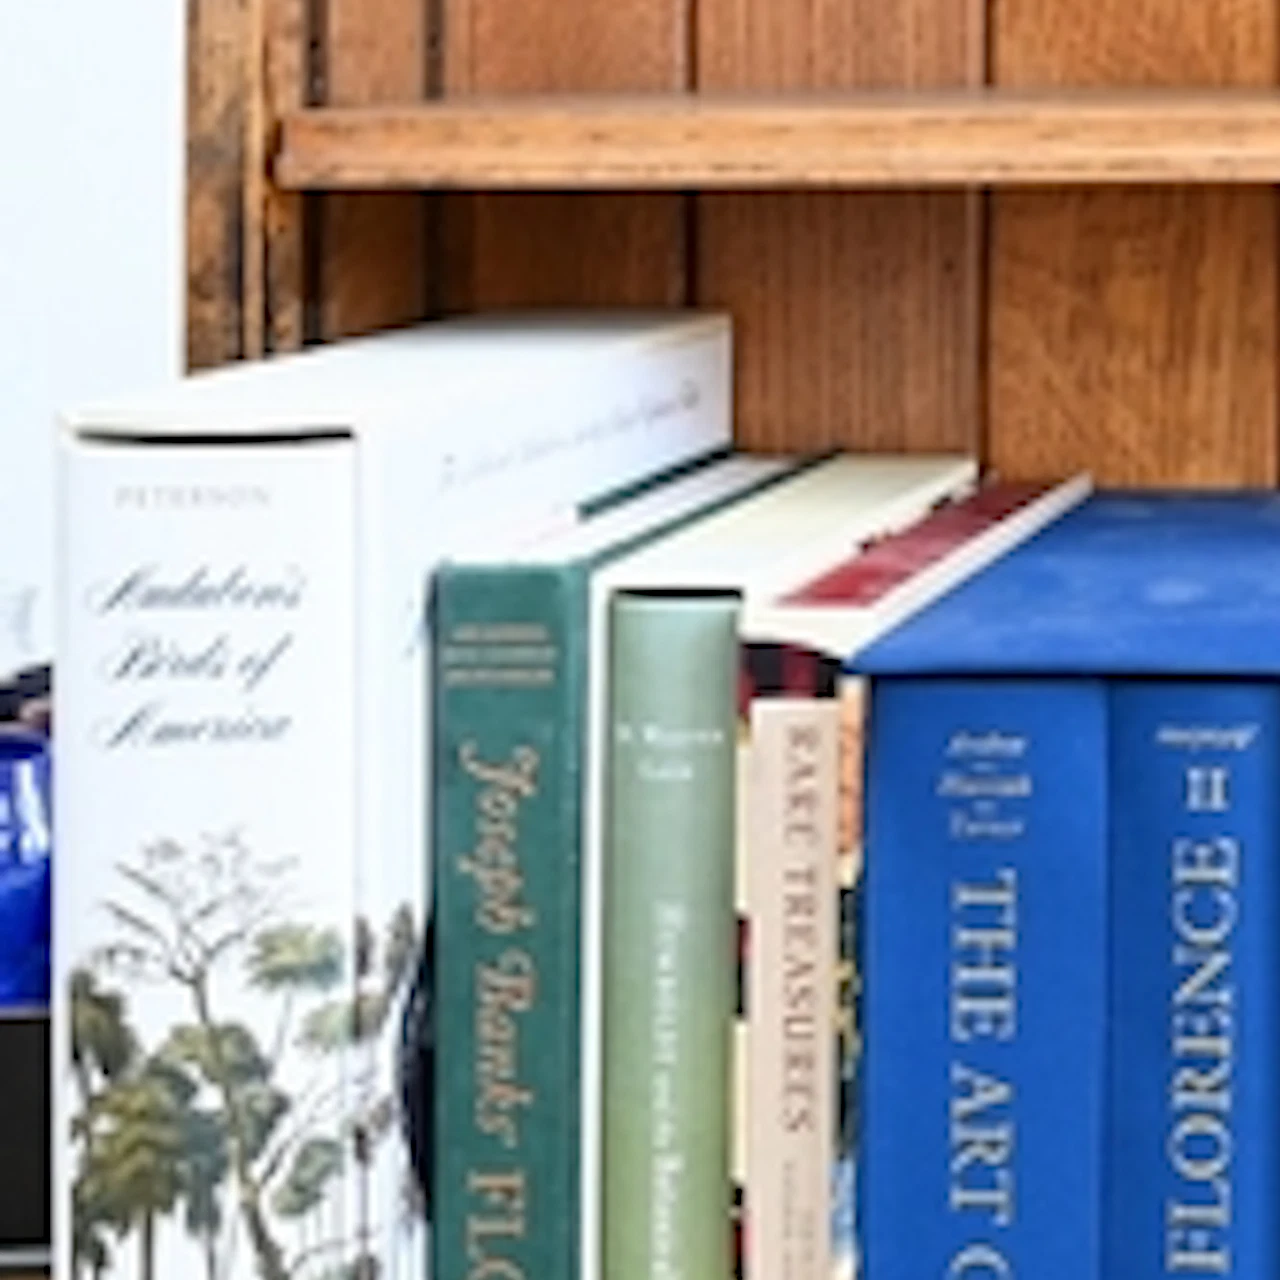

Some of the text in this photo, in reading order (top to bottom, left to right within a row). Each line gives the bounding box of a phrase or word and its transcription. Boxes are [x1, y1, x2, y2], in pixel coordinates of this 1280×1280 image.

[459, 740, 538, 932] Joseph
[781, 862, 821, 1134] TREASURES
[950, 867, 1018, 1044] THE
[948, 1061, 1016, 1227] ART
[1164, 837, 1241, 1274] FLORENCE
